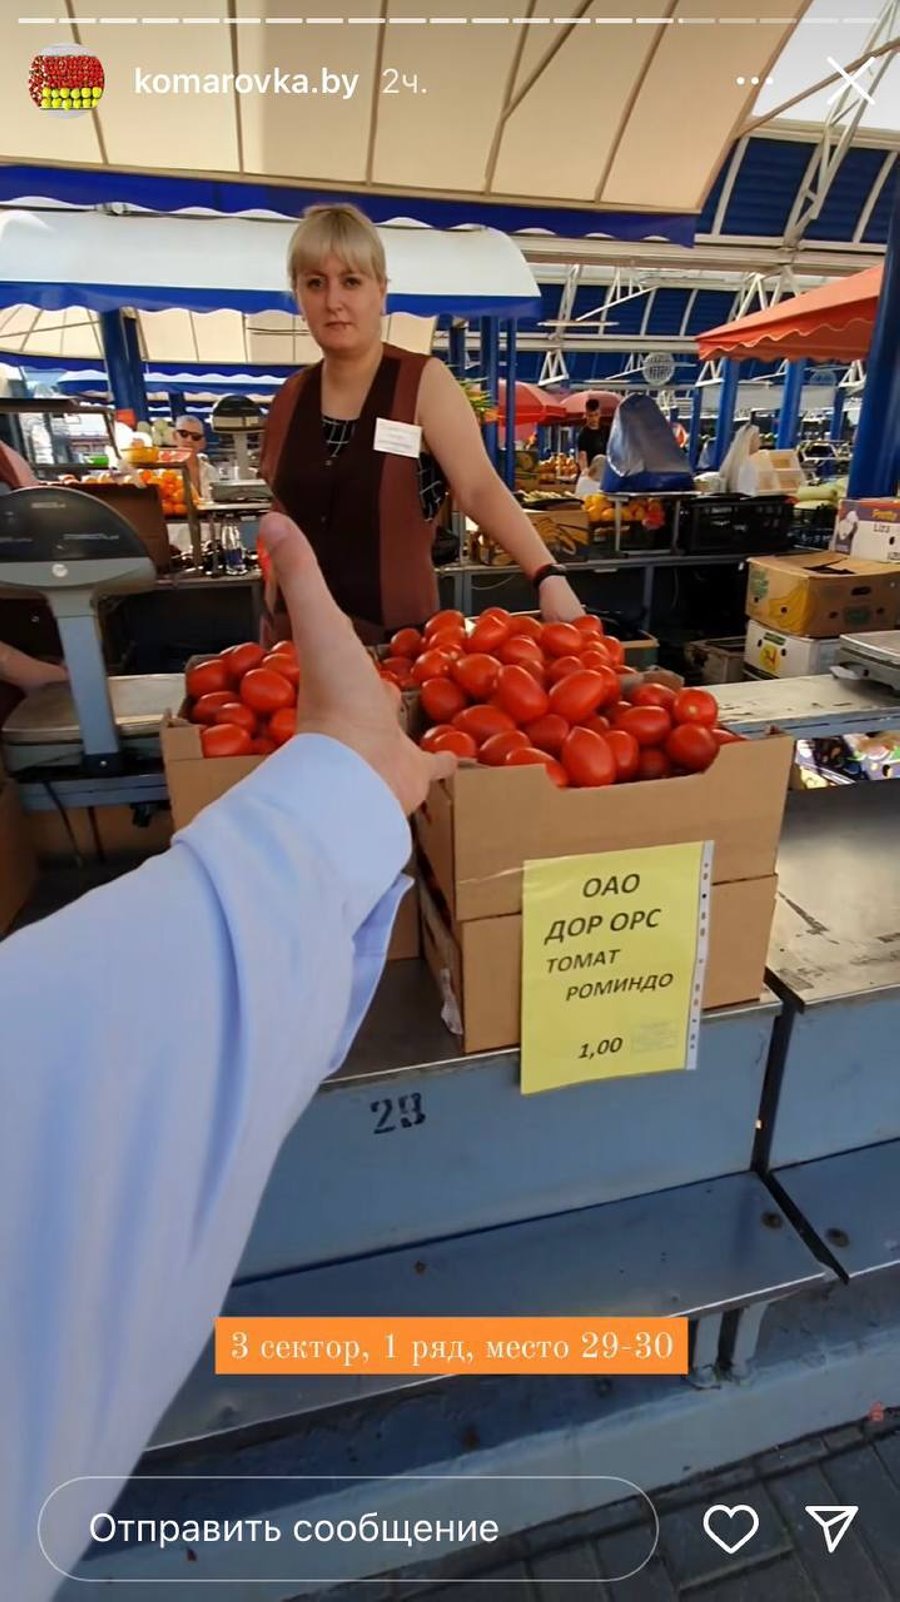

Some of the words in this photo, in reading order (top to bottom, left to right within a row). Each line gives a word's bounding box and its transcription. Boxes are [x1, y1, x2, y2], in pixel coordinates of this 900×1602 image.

[582, 873, 641, 898] ОАО
[543, 915, 604, 946] ДОР
[609, 908, 662, 932] ОРС
[546, 949, 621, 974] ТОМАТ
[565, 973, 674, 1001] РОМИНДО
[577, 1037, 624, 1060] 1,00
